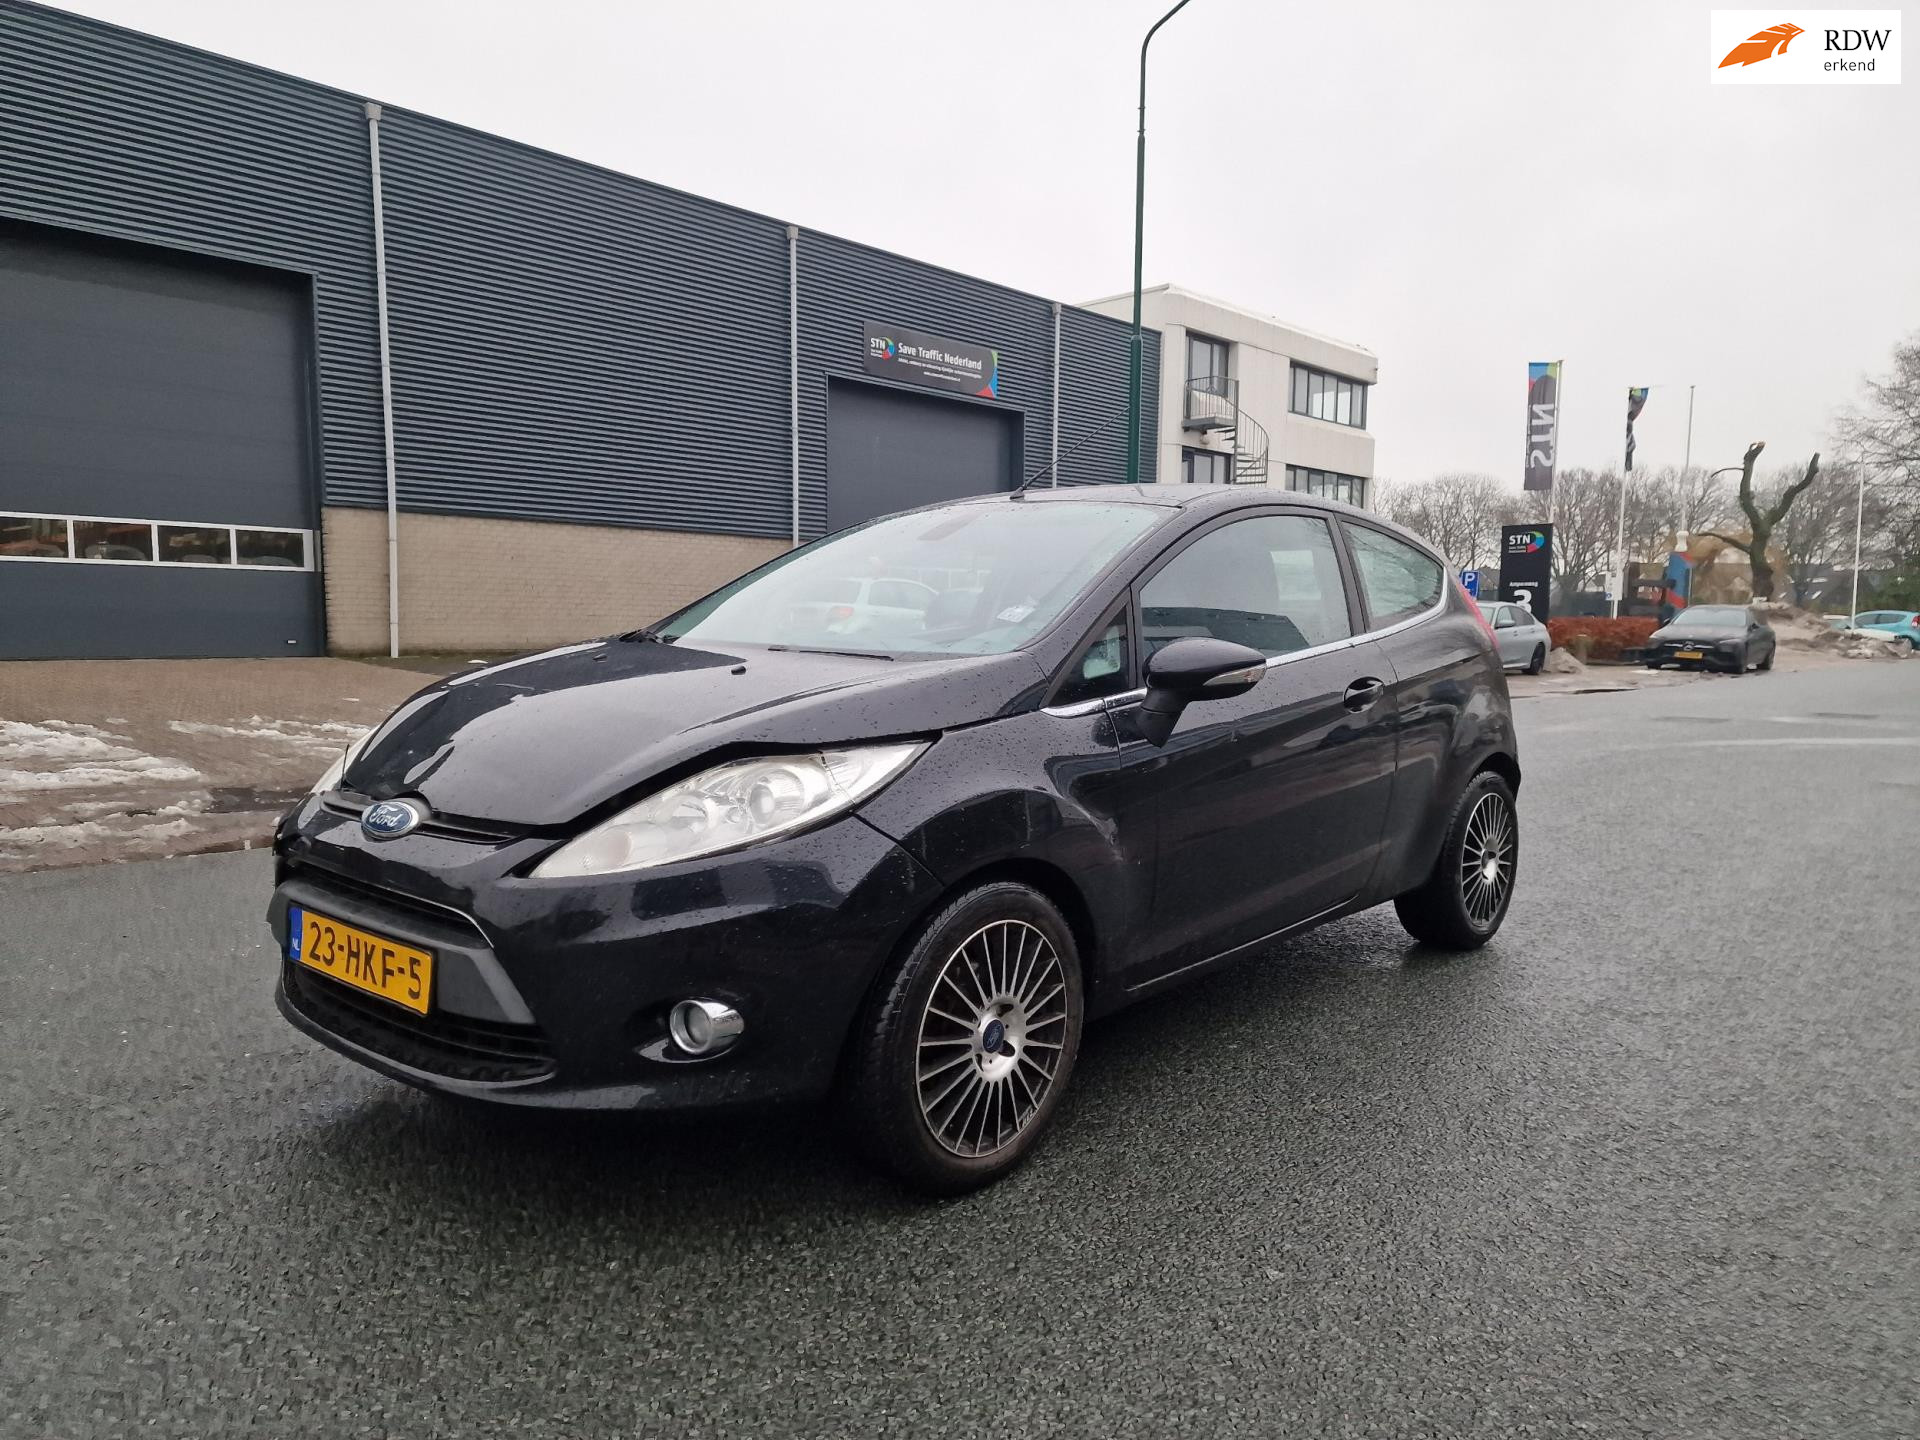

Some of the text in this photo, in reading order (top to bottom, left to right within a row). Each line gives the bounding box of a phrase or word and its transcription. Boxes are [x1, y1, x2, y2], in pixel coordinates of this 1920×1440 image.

[870, 338, 886, 350] STN
[898, 342, 917, 356] Save
[918, 346, 943, 362] Traffic
[944, 353, 982, 370] Nederland
[1508, 534, 1531, 545] STN
[1465, 572, 1476, 587] P
[1513, 589, 1532, 614] 3
[369, 804, 404, 828] Ford
[309, 921, 422, 1000] 23-HKF-5
